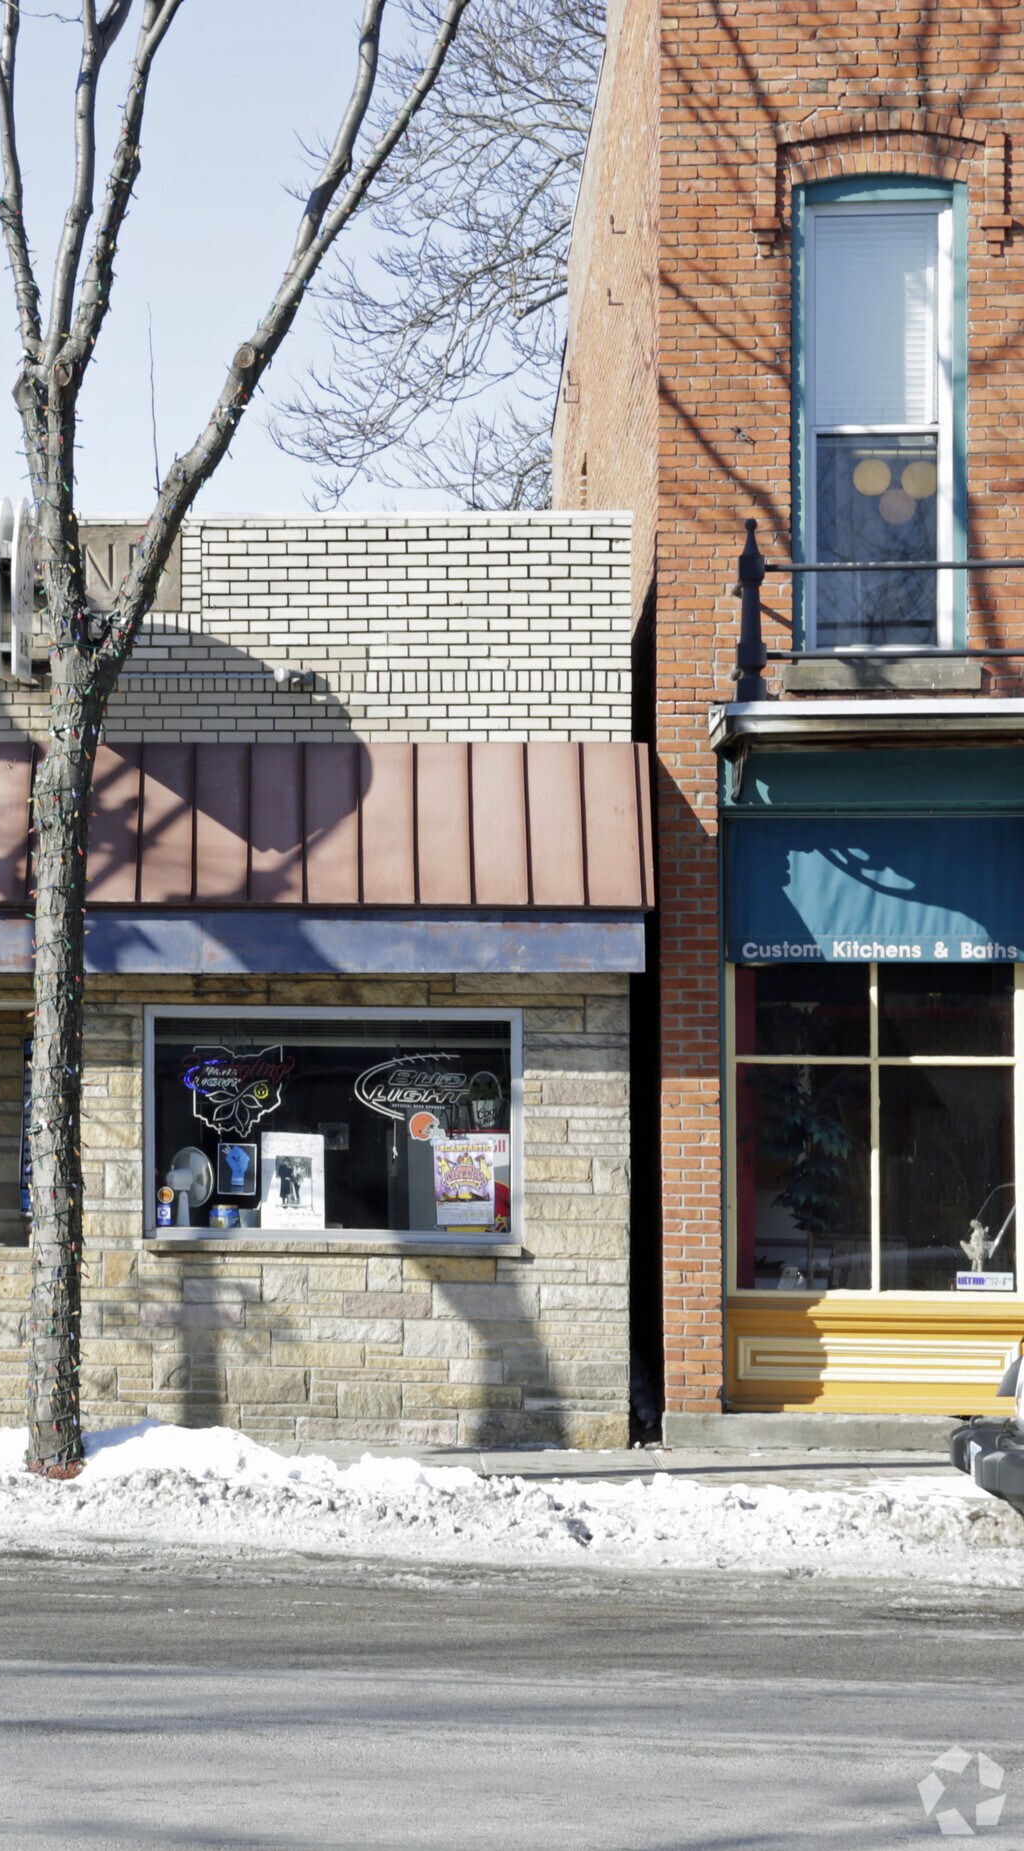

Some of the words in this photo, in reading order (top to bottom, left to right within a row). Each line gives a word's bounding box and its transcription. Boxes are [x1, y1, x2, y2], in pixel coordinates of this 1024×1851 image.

[742, 941, 821, 958] Custom
[832, 940, 922, 959] Kitchens
[933, 941, 948, 958] &
[960, 941, 1017, 959] Baths
[388, 1070, 467, 1087] BUD
[368, 1084, 470, 1103] LIGHT
